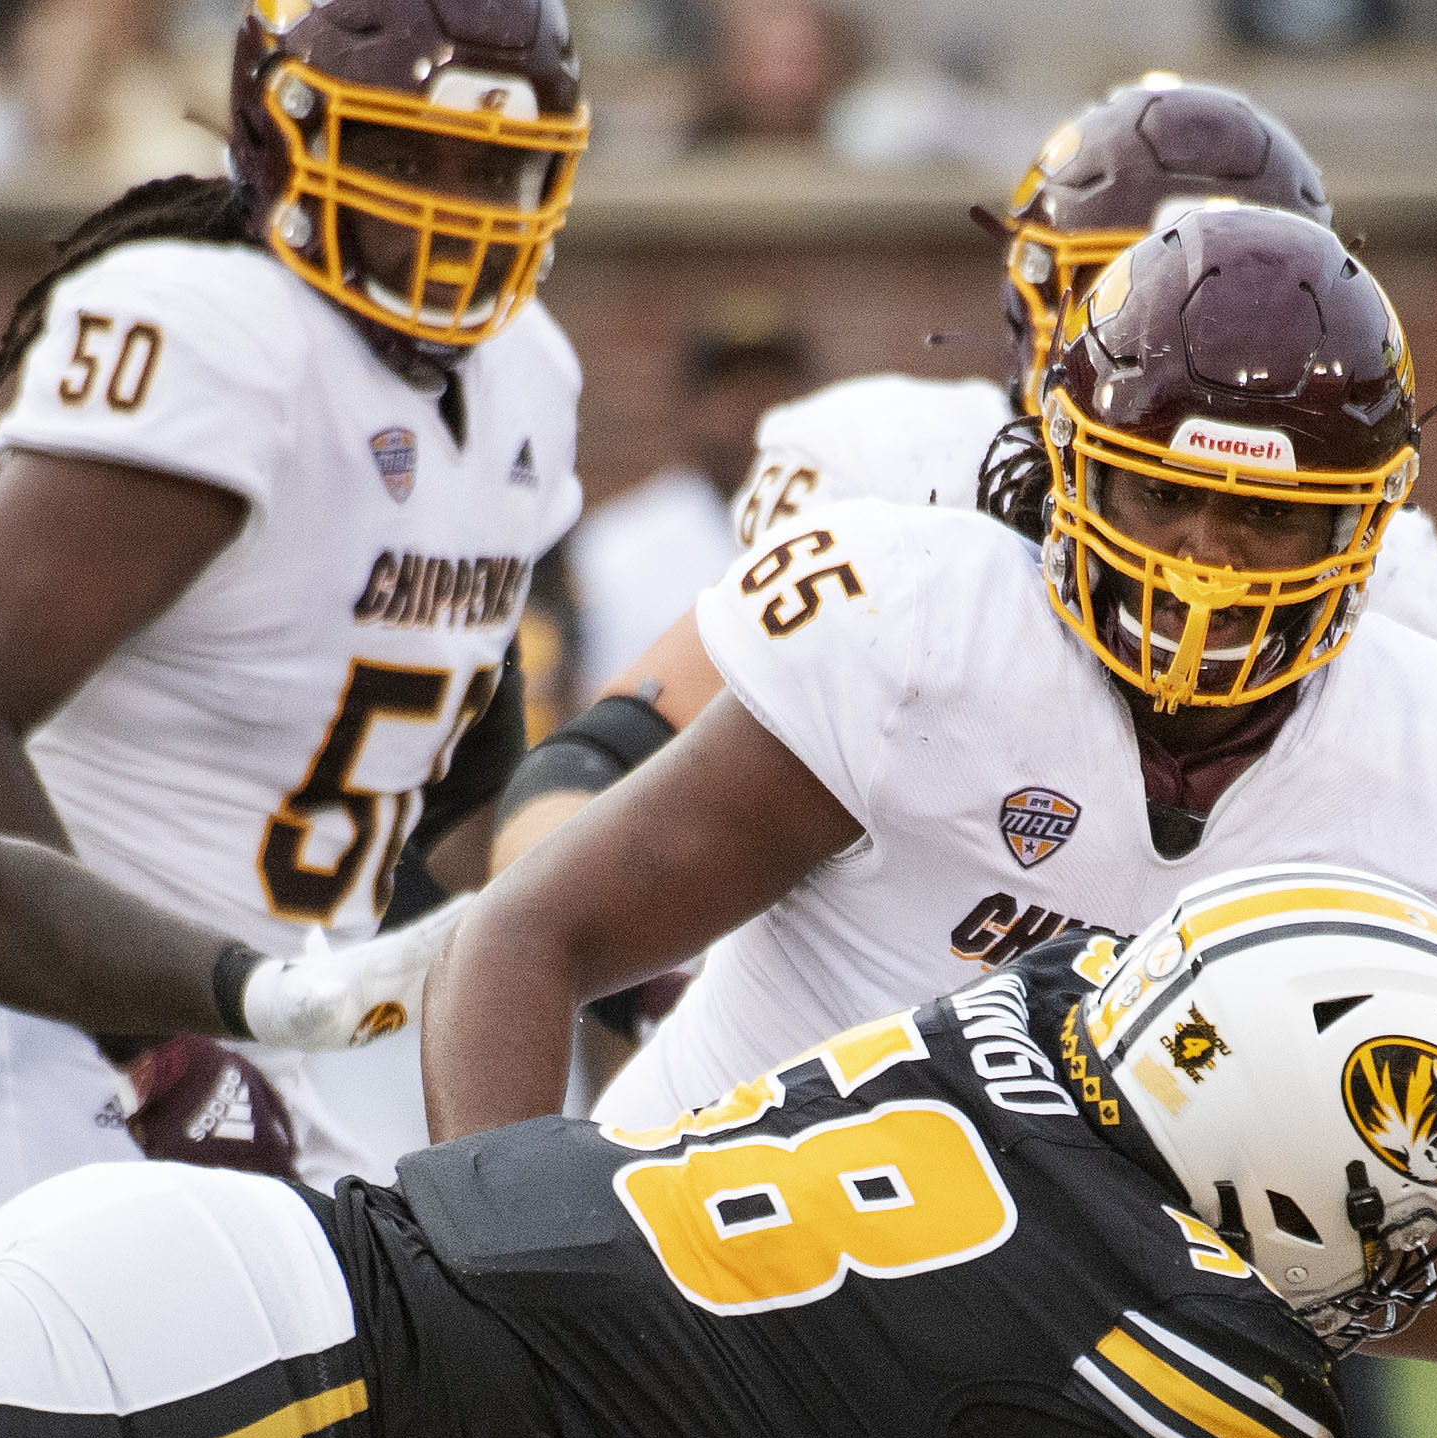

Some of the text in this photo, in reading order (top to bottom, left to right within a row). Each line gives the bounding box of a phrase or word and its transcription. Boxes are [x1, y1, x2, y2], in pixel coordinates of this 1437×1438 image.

[58, 309, 164, 415] 50
[740, 529, 867, 640] 65
[1001, 811, 1074, 838] MAC
